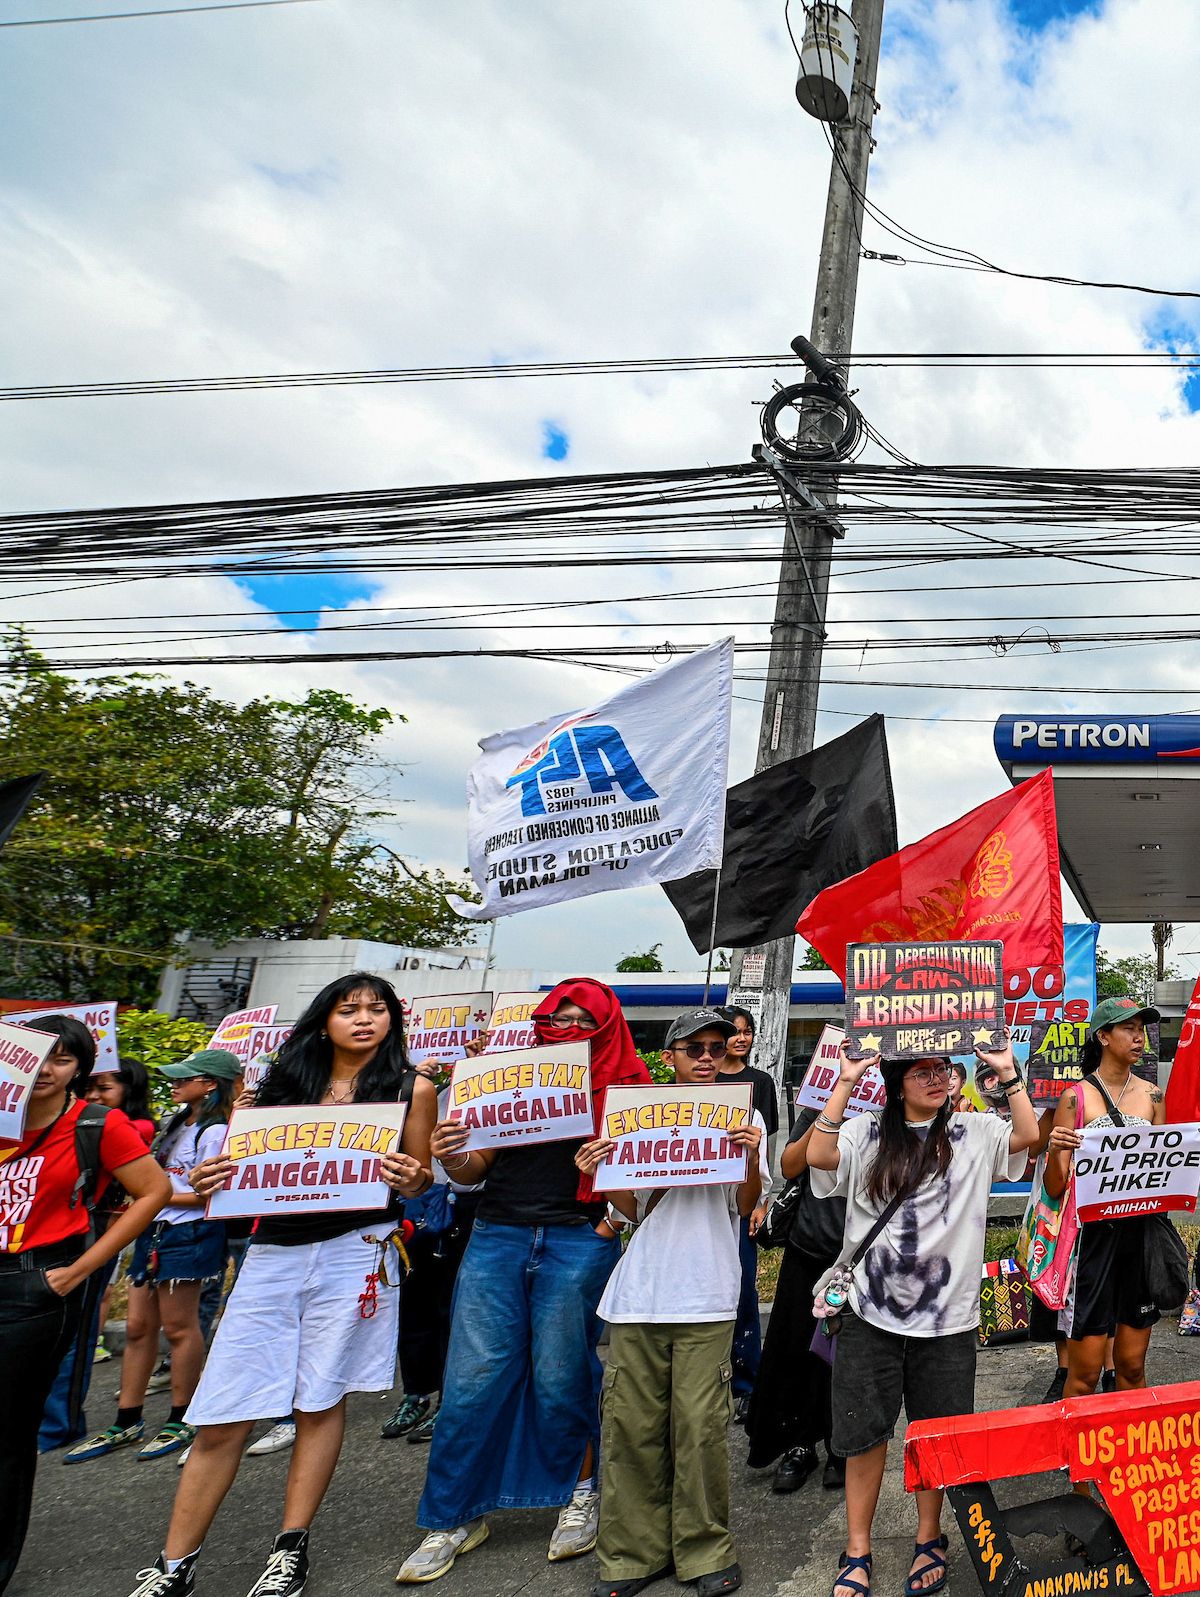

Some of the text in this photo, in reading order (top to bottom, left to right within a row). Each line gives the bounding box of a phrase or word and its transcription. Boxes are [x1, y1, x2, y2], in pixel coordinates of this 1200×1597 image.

[1012, 720, 1151, 748] PETRON
[854, 947, 996, 990] OIL DEREGULATION
[1003, 965, 1066, 999] 00
[85, 1009, 110, 1027] NG
[424, 1006, 471, 1030] VAT
[492, 1003, 538, 1027] EXCIS
[853, 990, 996, 1027] IBASURA!!
[410, 1029, 484, 1050] TANGGALI
[487, 1029, 537, 1047] TANGG
[1036, 1022, 1091, 1054] ART
[0, 1038, 39, 1074] ALISMO
[453, 1063, 587, 1106] EXCISE TAX
[606, 1102, 747, 1138] EXCISE TAX
[229, 1121, 397, 1161] EXCISE TAX
[606, 1137, 743, 1166] TANGGALIN
[1100, 1131, 1182, 1153] NO TO
[634, 1168, 708, 1178] ACAD UNION
[1075, 1156, 1114, 1176] OIL
[1098, 1171, 1171, 1194] HIKE!
[275, 1193, 329, 1202] PISARA
[1024, 1563, 1135, 1597] ANAKPAWIS PL
